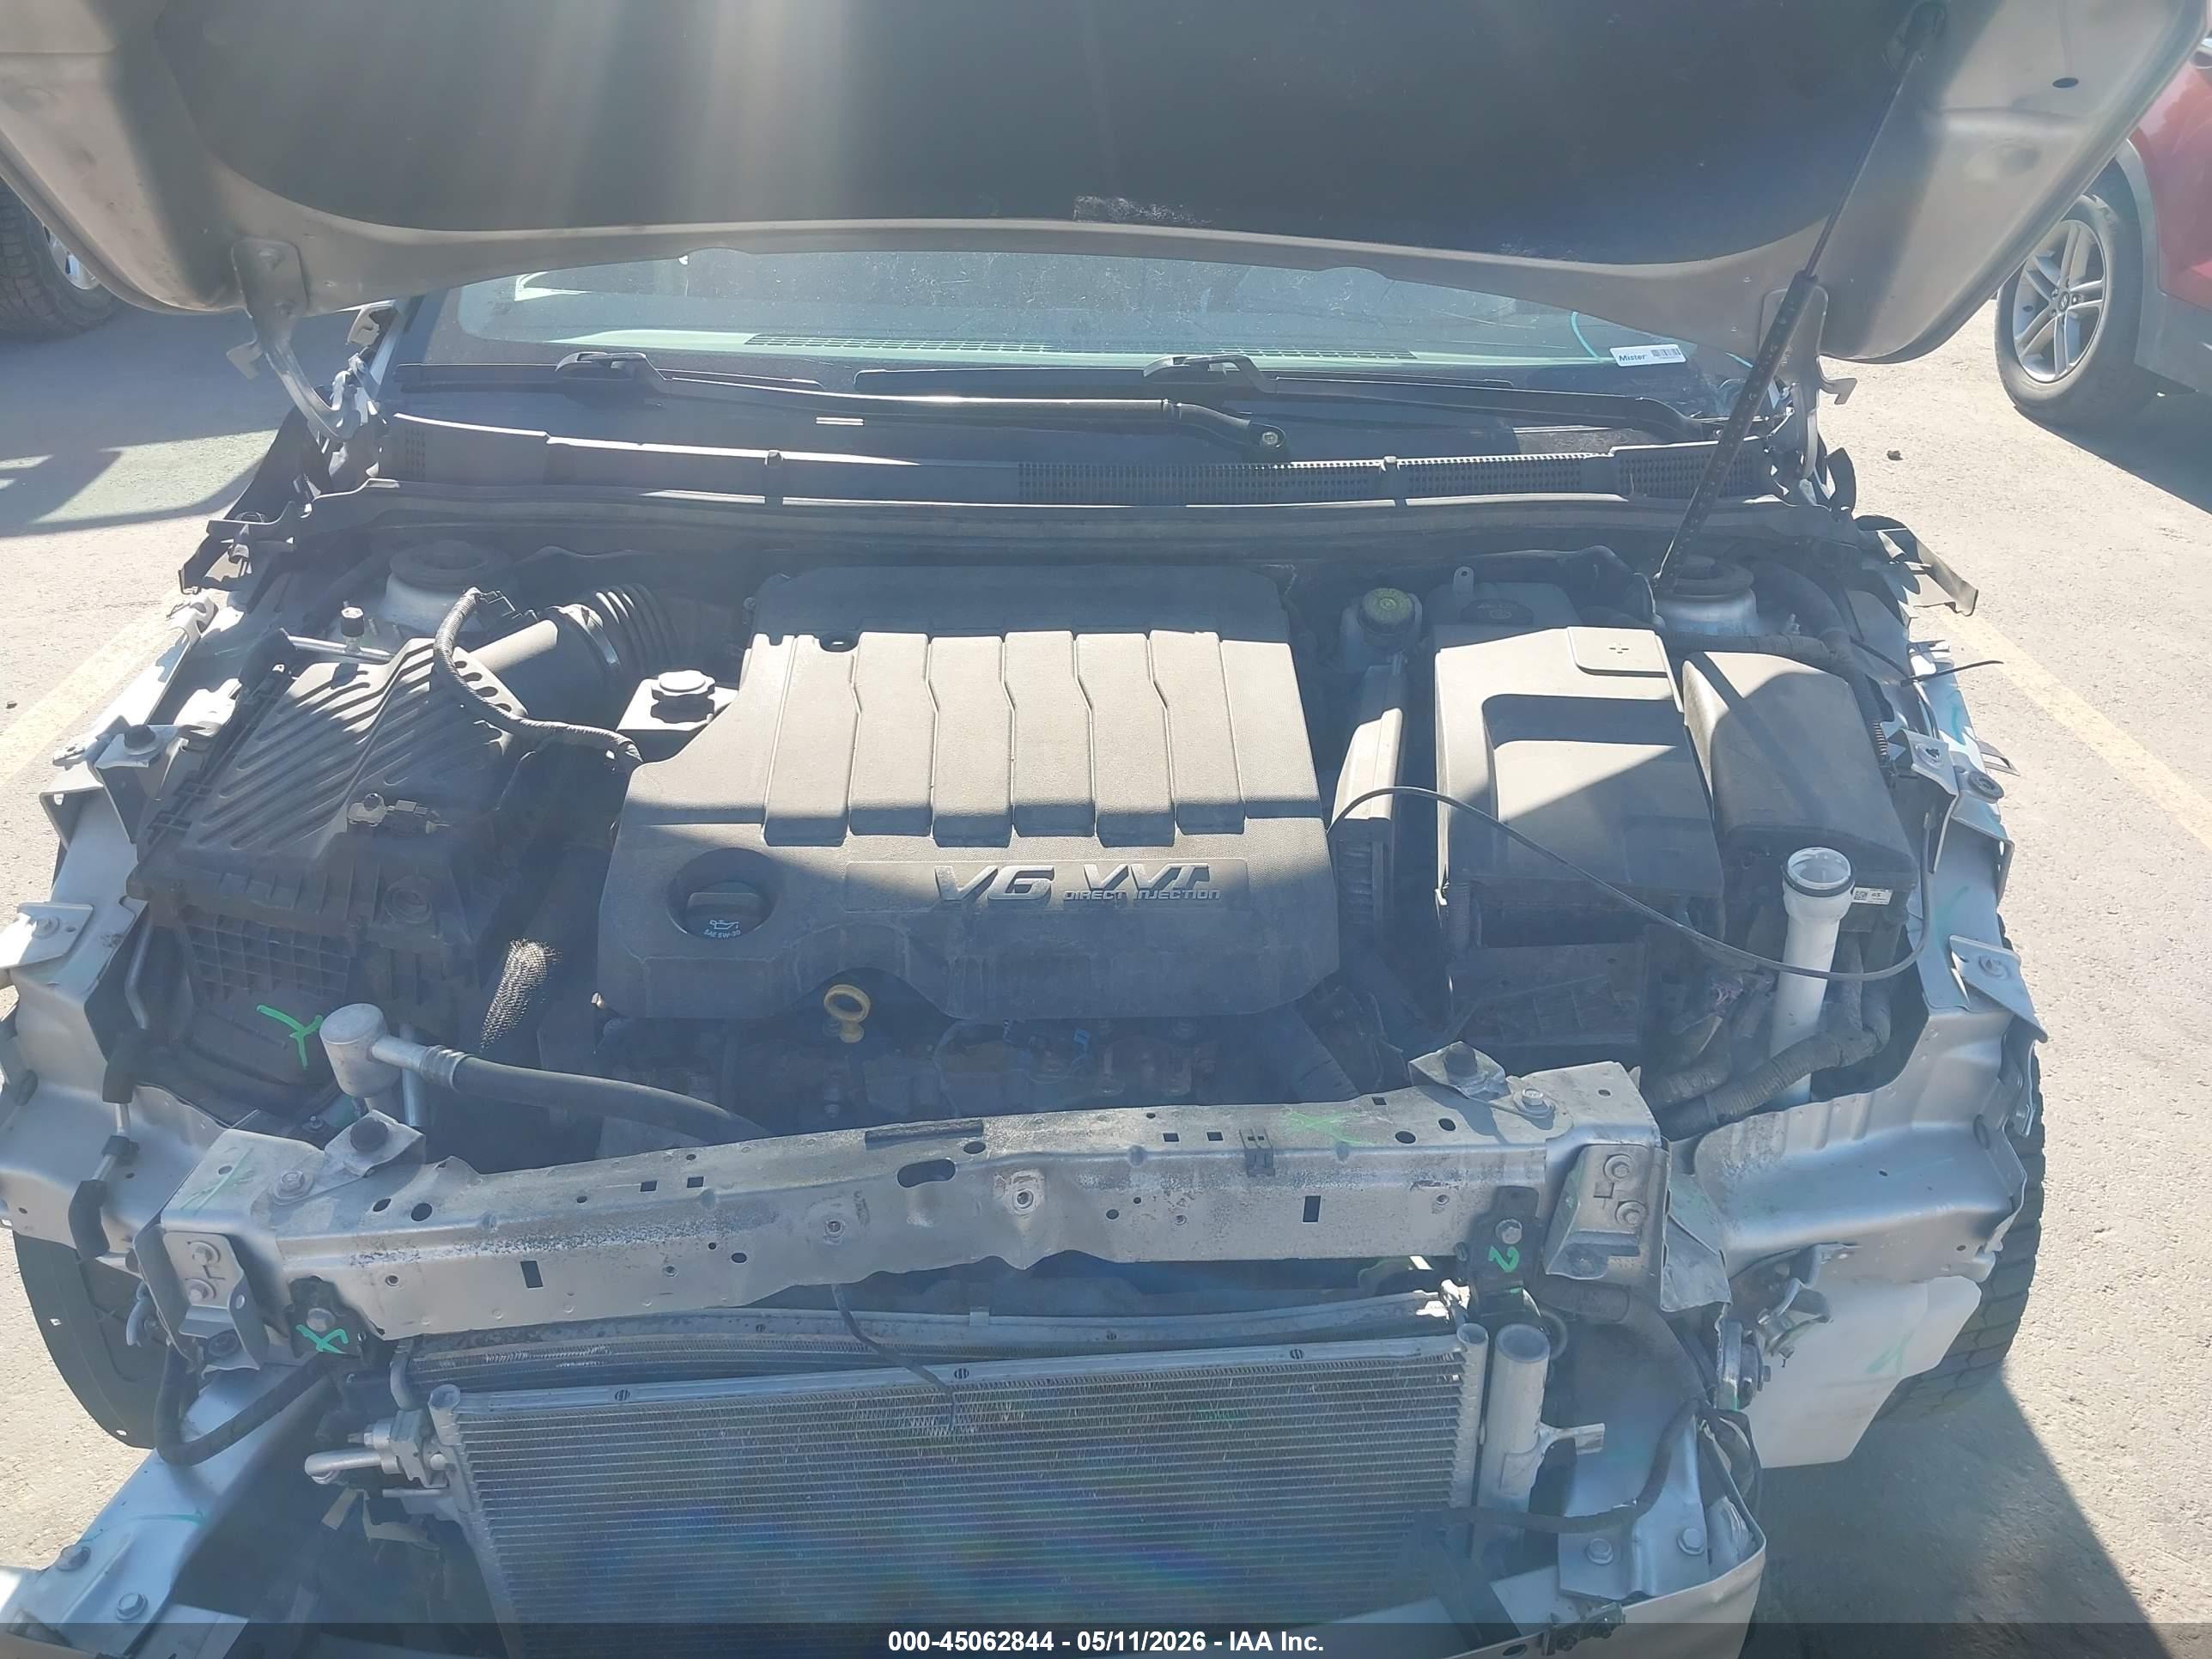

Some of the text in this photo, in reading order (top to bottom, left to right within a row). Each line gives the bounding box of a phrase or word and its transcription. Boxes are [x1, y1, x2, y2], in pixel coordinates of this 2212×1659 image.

[934, 863, 1211, 902] V6 VVT
[1063, 890, 1127, 901] DIRECT
